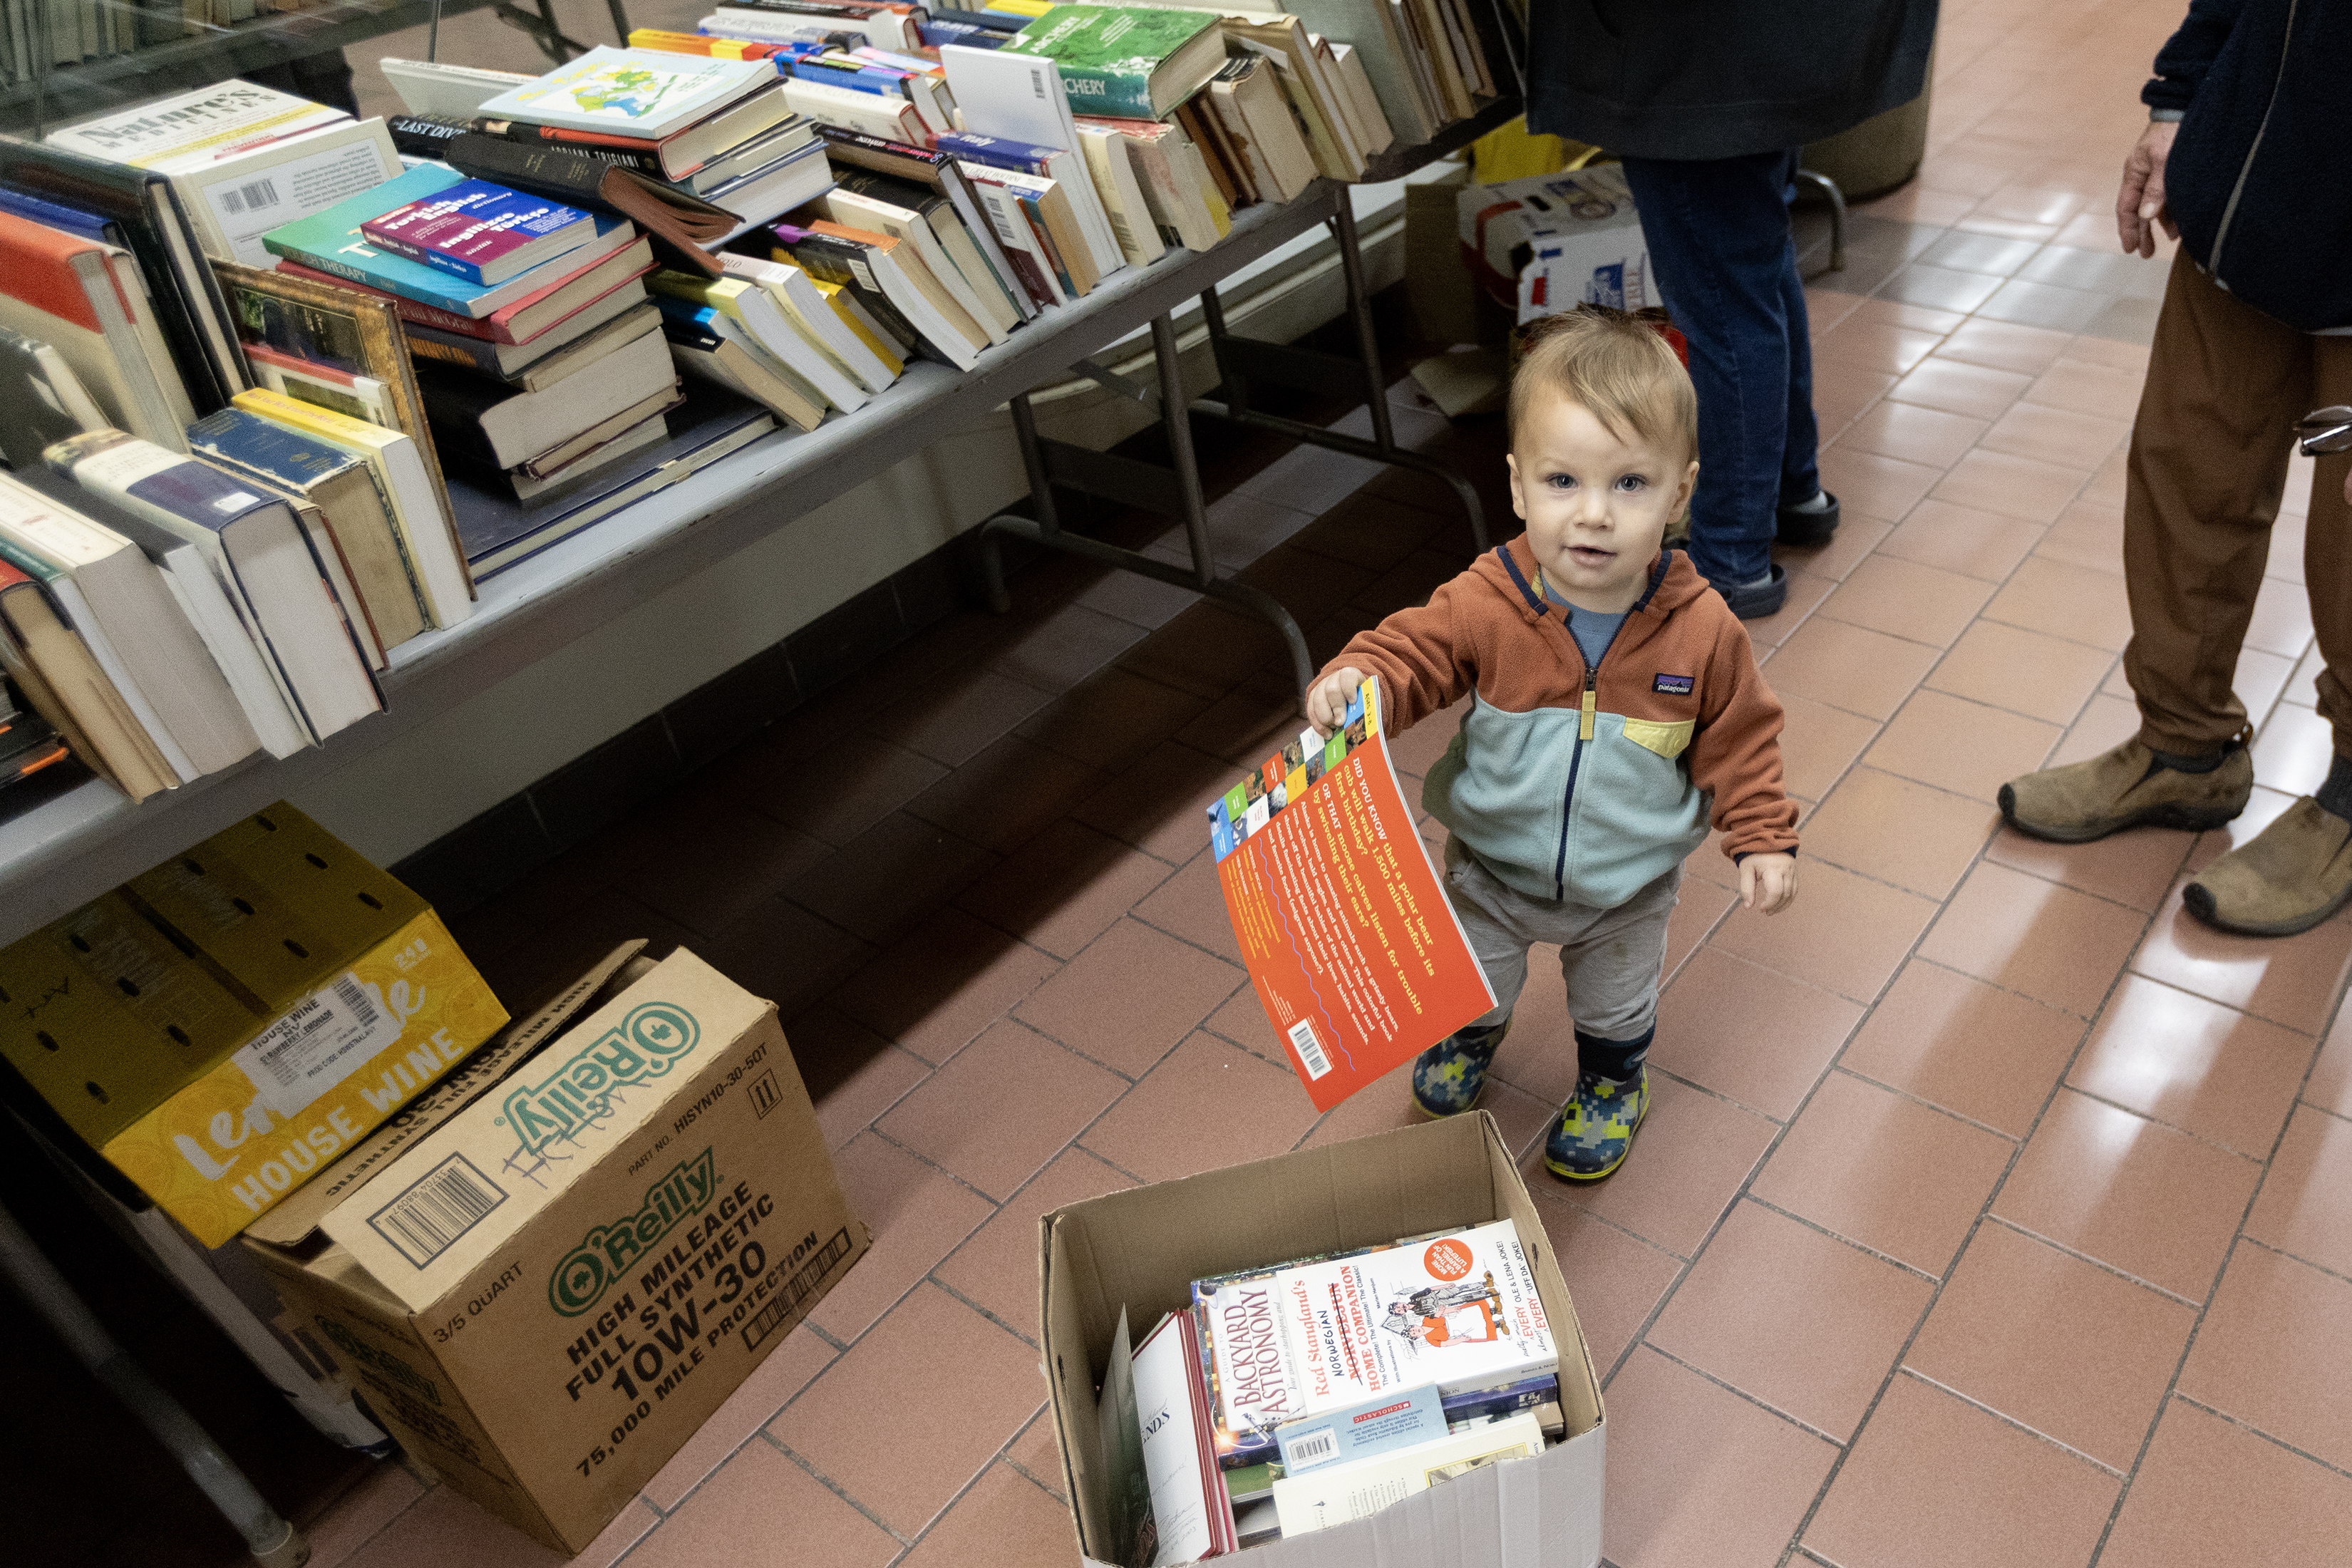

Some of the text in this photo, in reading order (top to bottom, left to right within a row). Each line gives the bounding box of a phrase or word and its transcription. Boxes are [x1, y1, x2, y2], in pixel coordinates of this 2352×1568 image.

[1029, 16, 1081, 54] ARCHERY
[1063, 78, 1106, 96] CHERY
[78, 86, 261, 144] Nature's
[398, 119, 431, 136] LAST
[385, 200, 452, 230] Turkish
[421, 192, 488, 220] English
[472, 191, 512, 210] dictionary
[321, 257, 366, 282] THERAPY
[1658, 684, 1689, 693] patagonia
[1300, 800, 1311, 830] Alaska
[1334, 770, 1346, 798] first
[1342, 797, 1368, 855] birthday?
[1309, 828, 1314, 838] is
[1311, 837, 1322, 862] home
[1313, 788, 1369, 927] by swiveling their ears?
[1352, 756, 1433, 945] DID YOU KNOW that a polar bear
[1320, 862, 1326, 872] to
[1343, 764, 1435, 976] cub will walk 1,500 miles before its
[1275, 821, 1285, 849] details
[1282, 848, 1301, 895] fascinating
[1298, 894, 1309, 915] facts
[1306, 915, 1319, 940] about
[1317, 940, 1329, 961] their
[1326, 960, 1338, 984] lives,
[1321, 783, 1422, 1014] OR THAT moose calves listen for trouble
[1324, 872, 1341, 909] amazing
[1284, 814, 1293, 840] shows
[1299, 867, 1317, 905] beautiful
[1314, 904, 1328, 933] babies
[1325, 933, 1334, 943] of
[1330, 943, 1339, 958] the
[1336, 959, 1354, 989] animal
[1351, 988, 1366, 1013] world
[1363, 1013, 1376, 1031] and
[1297, 827, 1309, 858] wolves,
[1307, 857, 1318, 877] bald
[1314, 877, 1327, 907] eagles,
[1326, 907, 1336, 924] and
[1333, 924, 1342, 940] sea
[1353, 965, 1364, 987] This
[1362, 987, 1382, 1020] colorful
[1379, 1019, 1392, 1042] book
[1338, 909, 1356, 944] animals
[1353, 944, 1366, 965] such
[1363, 965, 1371, 976] as
[1368, 976, 1386, 1004] grizzly
[289, 998, 320, 1023] WINE
[300, 1009, 333, 1035] LEMONADE
[476, 1011, 555, 1079] MILEAGE
[501, 1001, 701, 1155] O'Reilly
[432, 1076, 475, 1114] FULL
[231, 1109, 366, 1213] HOUSE
[359, 1026, 465, 1115] WINE
[324, 1112, 429, 1198] SYNTHETIC
[626, 1149, 656, 1176] PART
[653, 1131, 674, 1153] NO.
[549, 1147, 713, 1317] O'Reilly
[1432, 1251, 1457, 1274] FUN THAN
[1442, 1244, 1467, 1266] LUTEFISK!
[1442, 1250, 1461, 1270] BARREL
[1496, 1240, 1507, 1261] JOKE!
[1511, 1241, 1523, 1262] JOKE!
[564, 1180, 754, 1366] HIGH MILEAGE
[1353, 1265, 1362, 1287] Classic!
[1431, 1259, 1447, 1274] MORE
[1503, 1262, 1514, 1280] LENA
[432, 1261, 527, 1344] 3/5 QUART
[564, 1331, 636, 1402] FULL
[639, 1192, 777, 1332] SYNTHETIC
[1274, 1301, 1282, 1314] and
[1512, 1288, 1521, 1302] OLE
[607, 1238, 773, 1401] 10W-30
[1340, 1265, 1380, 1391] HOME COMPANION
[1362, 1301, 1373, 1327] Ultimate!
[1515, 1306, 1533, 1337] EVERY
[1527, 1298, 1546, 1329] EVERY
[1239, 1289, 1289, 1412] ASTRONOMY
[1292, 1279, 1329, 1396] Red Stangland's
[1316, 1310, 1343, 1376] NORWEGIAN
[575, 1230, 820, 1477] 75,000 MILE PROTECTION
[1224, 1304, 1262, 1407] BACKYARD
[1284, 1358, 1294, 1375] guide
[1373, 1341, 1385, 1373] Complete!
[1388, 1346, 1397, 1371] Illustrations
[1288, 1377, 1297, 1391] Your
[1353, 1404, 1403, 1422] SCHOLASTIC
